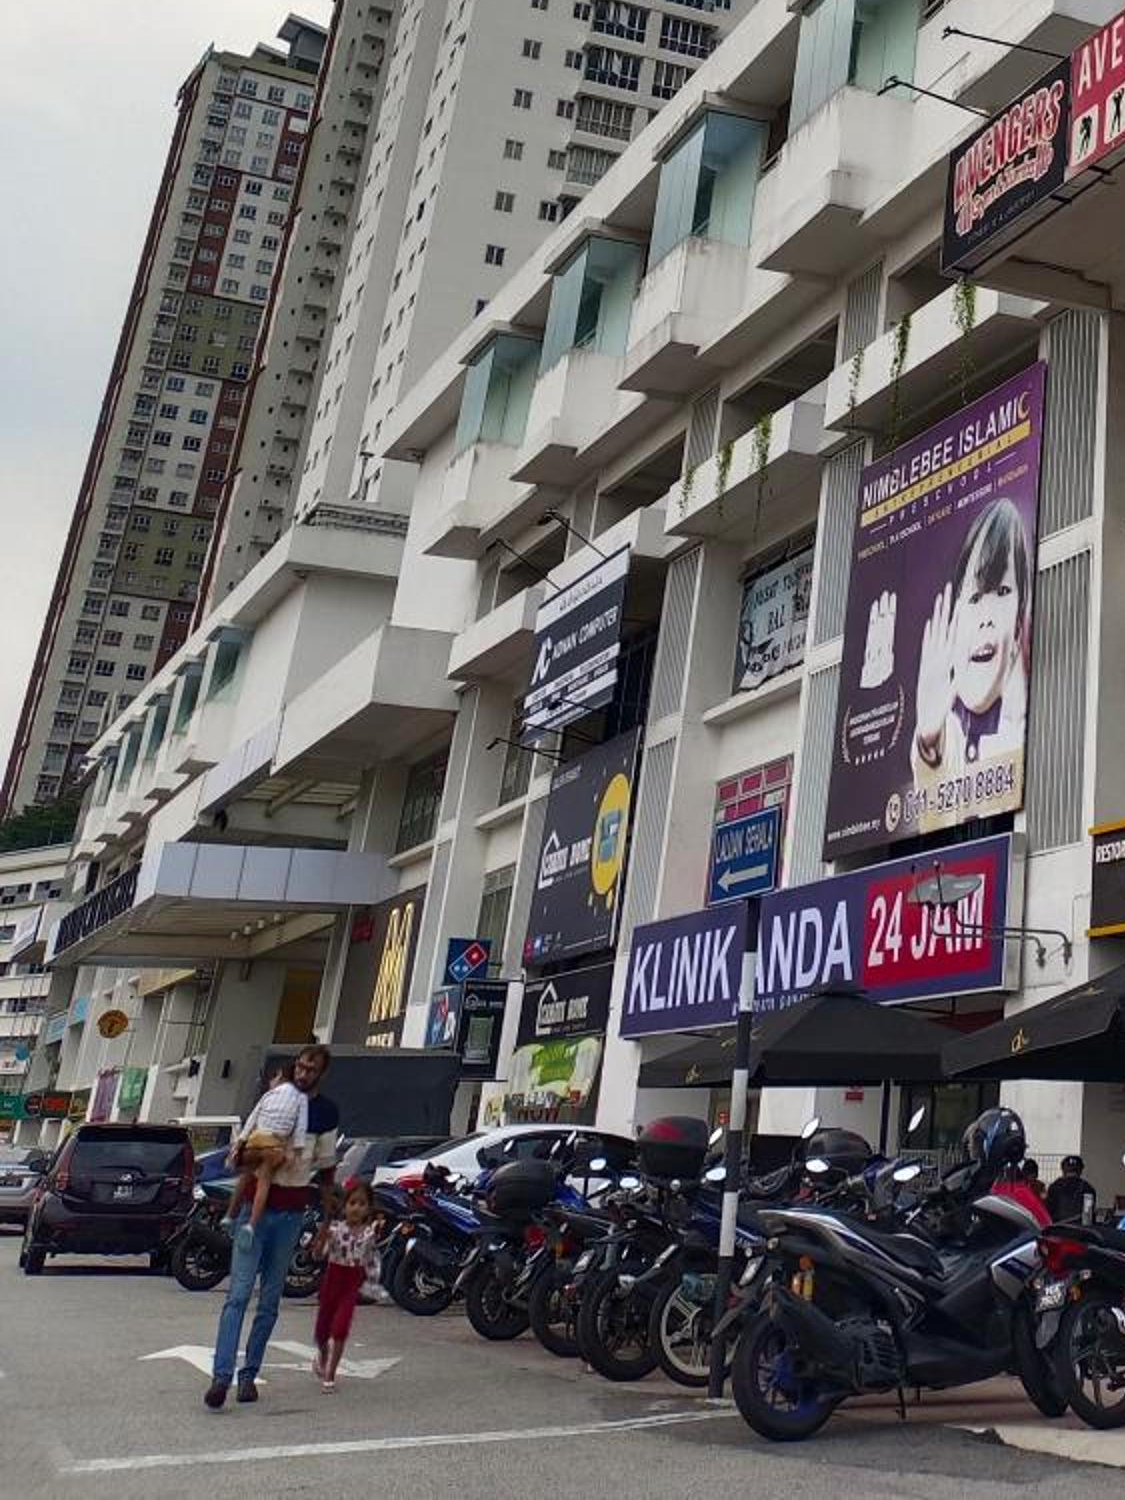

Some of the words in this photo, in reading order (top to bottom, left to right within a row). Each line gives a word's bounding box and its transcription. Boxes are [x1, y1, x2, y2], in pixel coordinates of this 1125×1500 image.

[954, 79, 1064, 214] AVENGERS
[864, 436, 953, 508] NIMBLEBEE
[958, 391, 1030, 457] ISLAMIC
[890, 462, 991, 524] PRESCHOOL
[577, 605, 619, 645] COMPUTER
[628, 925, 736, 1014] KLINIK
[738, 901, 852, 996] ANDA
[867, 891, 903, 968] 24
[911, 873, 985, 960] JAM
